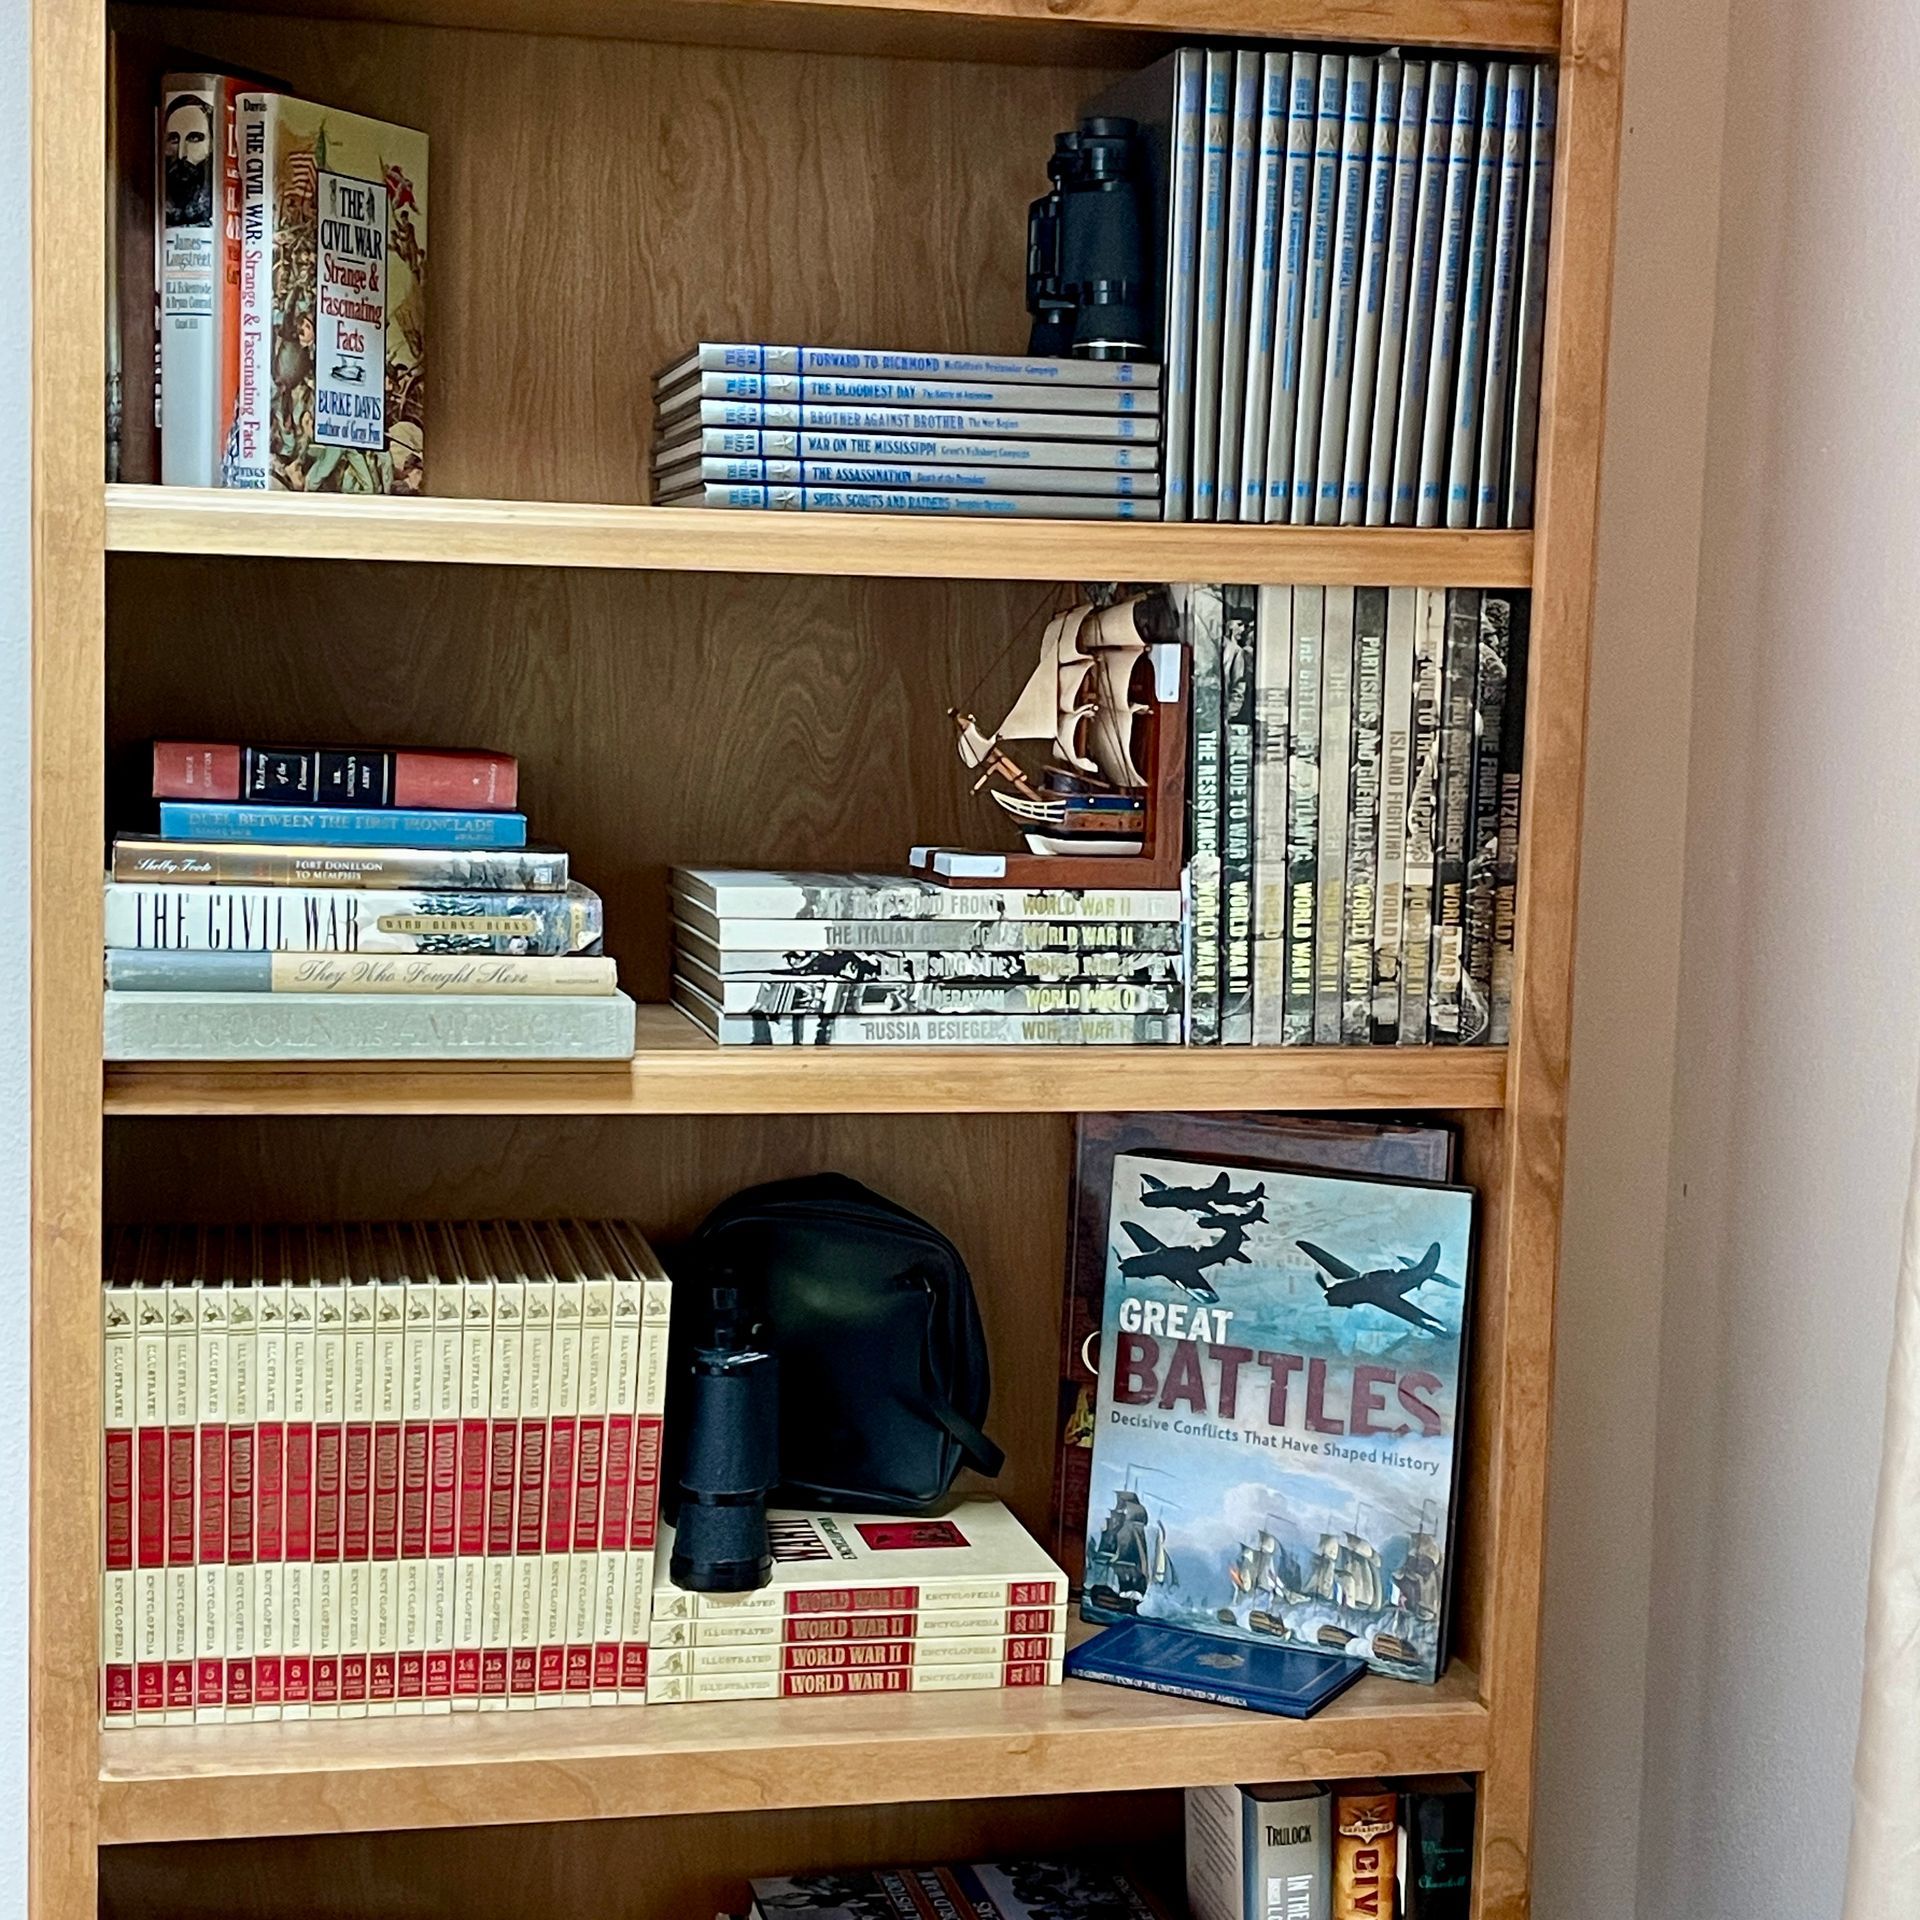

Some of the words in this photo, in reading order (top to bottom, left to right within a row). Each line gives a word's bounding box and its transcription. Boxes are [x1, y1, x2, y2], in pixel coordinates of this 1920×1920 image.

[246, 121, 264, 154] THE
[246, 159, 264, 200] CIVIL
[340, 187, 365, 221] THE
[1342, 166, 1361, 244] CONFEDERATE
[174, 235, 201, 251] James
[321, 219, 354, 255] CIVIL
[354, 226, 383, 260] WAR
[165, 251, 212, 271] Longstreet
[324, 253, 367, 294] Strange
[369, 265, 380, 292] &
[242, 250, 263, 308] Strange
[243, 313, 262, 326] &
[320, 286, 383, 330] Fascinating
[337, 321, 365, 353] Facts
[241, 333, 262, 415] Fascinating
[810, 352, 860, 368] FORWARD
[864, 355, 880, 369] TO
[882, 355, 940, 372] RICHMOND
[318, 389, 352, 418] BURKE
[354, 394, 382, 421] DAVIS
[811, 382, 832, 395] THE
[835, 383, 893, 398] BLOODIEST
[896, 385, 916, 398] DAY
[317, 420, 341, 438] author
[810, 411, 862, 427] BROTHER
[863, 412, 911, 428] AGAINST
[912, 414, 964, 430] BROTHER
[243, 421, 261, 459] Facts
[808, 437, 830, 451] WAR
[832, 439, 847, 452] ON
[851, 439, 871, 453] THE
[874, 440, 937, 457] MISSISSIPPI
[812, 466, 833, 481] THE
[835, 467, 912, 486] ASSASSINATION
[845, 493, 884, 509] SCOUTS
[886, 494, 907, 509] AND
[908, 495, 950, 511] RAIDERS
[1358, 635, 1381, 724] PARTISANS
[1418, 640, 1438, 702] RETURN
[1418, 706, 1435, 726] TO
[1198, 730, 1217, 761] THE
[1228, 724, 1248, 795] PRELUDE
[1357, 727, 1377, 761] AND
[1387, 730, 1407, 787] ISLAND
[189, 812, 230, 826] DUEL
[238, 813, 315, 828] BETWEEN
[319, 815, 349, 829] THE
[355, 816, 399, 830] FIRST
[404, 817, 496, 832] IRONCLADS
[1197, 764, 1217, 858] RESISTANCE
[1229, 798, 1248, 818] TO
[1351, 765, 1375, 862] GUERRILLAS
[1228, 821, 1248, 860] WAR
[1384, 791, 1405, 861] FIGHTING
[133, 857, 178, 874] Shelby
[295, 860, 322, 871] FORT
[324, 860, 383, 872] DONELSON
[295, 870, 311, 881] TO
[312, 870, 362, 881] MEMPHIS
[132, 892, 190, 949] THE
[208, 894, 289, 950] CIVIL
[304, 894, 361, 953] WAR
[1022, 896, 1076, 916] WORLD
[1081, 897, 1115, 917] WAR
[1120, 897, 1132, 916] II
[1196, 881, 1217, 937] WORLD
[1228, 881, 1249, 938] WORLD
[1292, 881, 1313, 938] WORLD
[1351, 883, 1372, 938] WORLD
[1380, 881, 1399, 937] WORLD
[1441, 882, 1461, 937] WORLD
[1495, 885, 1515, 940] WORLD
[386, 920, 422, 931] WARD
[824, 926, 850, 945] THE
[858, 926, 915, 945] ITALIAN
[1023, 926, 1079, 947] WORLD
[1081, 926, 1118, 947] WAR
[1120, 926, 1134, 946] II
[294, 959, 347, 990] They
[351, 960, 396, 985] Who
[401, 961, 476, 990] Fought
[477, 962, 529, 985] Here
[1196, 940, 1217, 977] WAR
[1228, 940, 1249, 978] WAR
[1291, 941, 1312, 979] WAR
[1349, 943, 1370, 980] WAR
[1406, 942, 1427, 977] WAR
[918, 987, 1006, 1009] LIBERATION
[1025, 989, 1080, 1009] WORLD
[865, 1021, 921, 1041] RUSSIA
[1080, 1020, 1114, 1040] WAR
[1118, 1296, 1235, 1345] GREAT
[266, 1341, 277, 1413] ILLUSTRATED
[500, 1339, 511, 1409] ILLUSTRATED
[618, 1335, 629, 1405] ILLUSTRATED
[646, 1335, 658, 1405] ILLUSTRATED
[1112, 1330, 1444, 1437] BATTLES
[522, 1429, 544, 1484] WORLD
[638, 1426, 660, 1481] WORLD
[1111, 1410, 1170, 1433] Decisive
[1173, 1419, 1239, 1443] Conflicts
[1244, 1429, 1278, 1449] That
[1281, 1435, 1319, 1455] Have
[1322, 1442, 1377, 1465] Shaped
[1381, 1451, 1441, 1476] History
[521, 1488, 541, 1524] WAR
[636, 1485, 655, 1521] WAR
[349, 1568, 359, 1648] ENCYCLOPEDIA
[549, 1560, 560, 1639] ENCYCLOPEDIA
[604, 1557, 616, 1636] ENCYCLOPEDIA
[145, 1575, 155, 1656] ENCYCLOPEDIA
[703, 1626, 775, 1638] ILLUSTRATED
[794, 1619, 848, 1640] WORLD
[851, 1617, 890, 1638] WAR
[891, 1616, 905, 1636] II
[923, 1618, 1000, 1629] ENCYCLOPEDIA
[344, 1663, 363, 1678] 10
[374, 1664, 390, 1677] 11
[403, 1661, 420, 1675] 12
[429, 1660, 447, 1674] 13
[485, 1656, 502, 1671] 15
[542, 1655, 559, 1668] 17
[569, 1654, 587, 1668] 18
[791, 1647, 846, 1667] WORLD
[849, 1645, 886, 1664] WAR
[889, 1644, 903, 1663] II
[790, 1673, 844, 1694] WORLD
[847, 1672, 884, 1690] WAR
[887, 1671, 901, 1689] II
[1217, 1694, 1248, 1707] AMERICA
[1265, 1824, 1312, 1847] TRULOCK
[1287, 1873, 1313, 1891] IN
